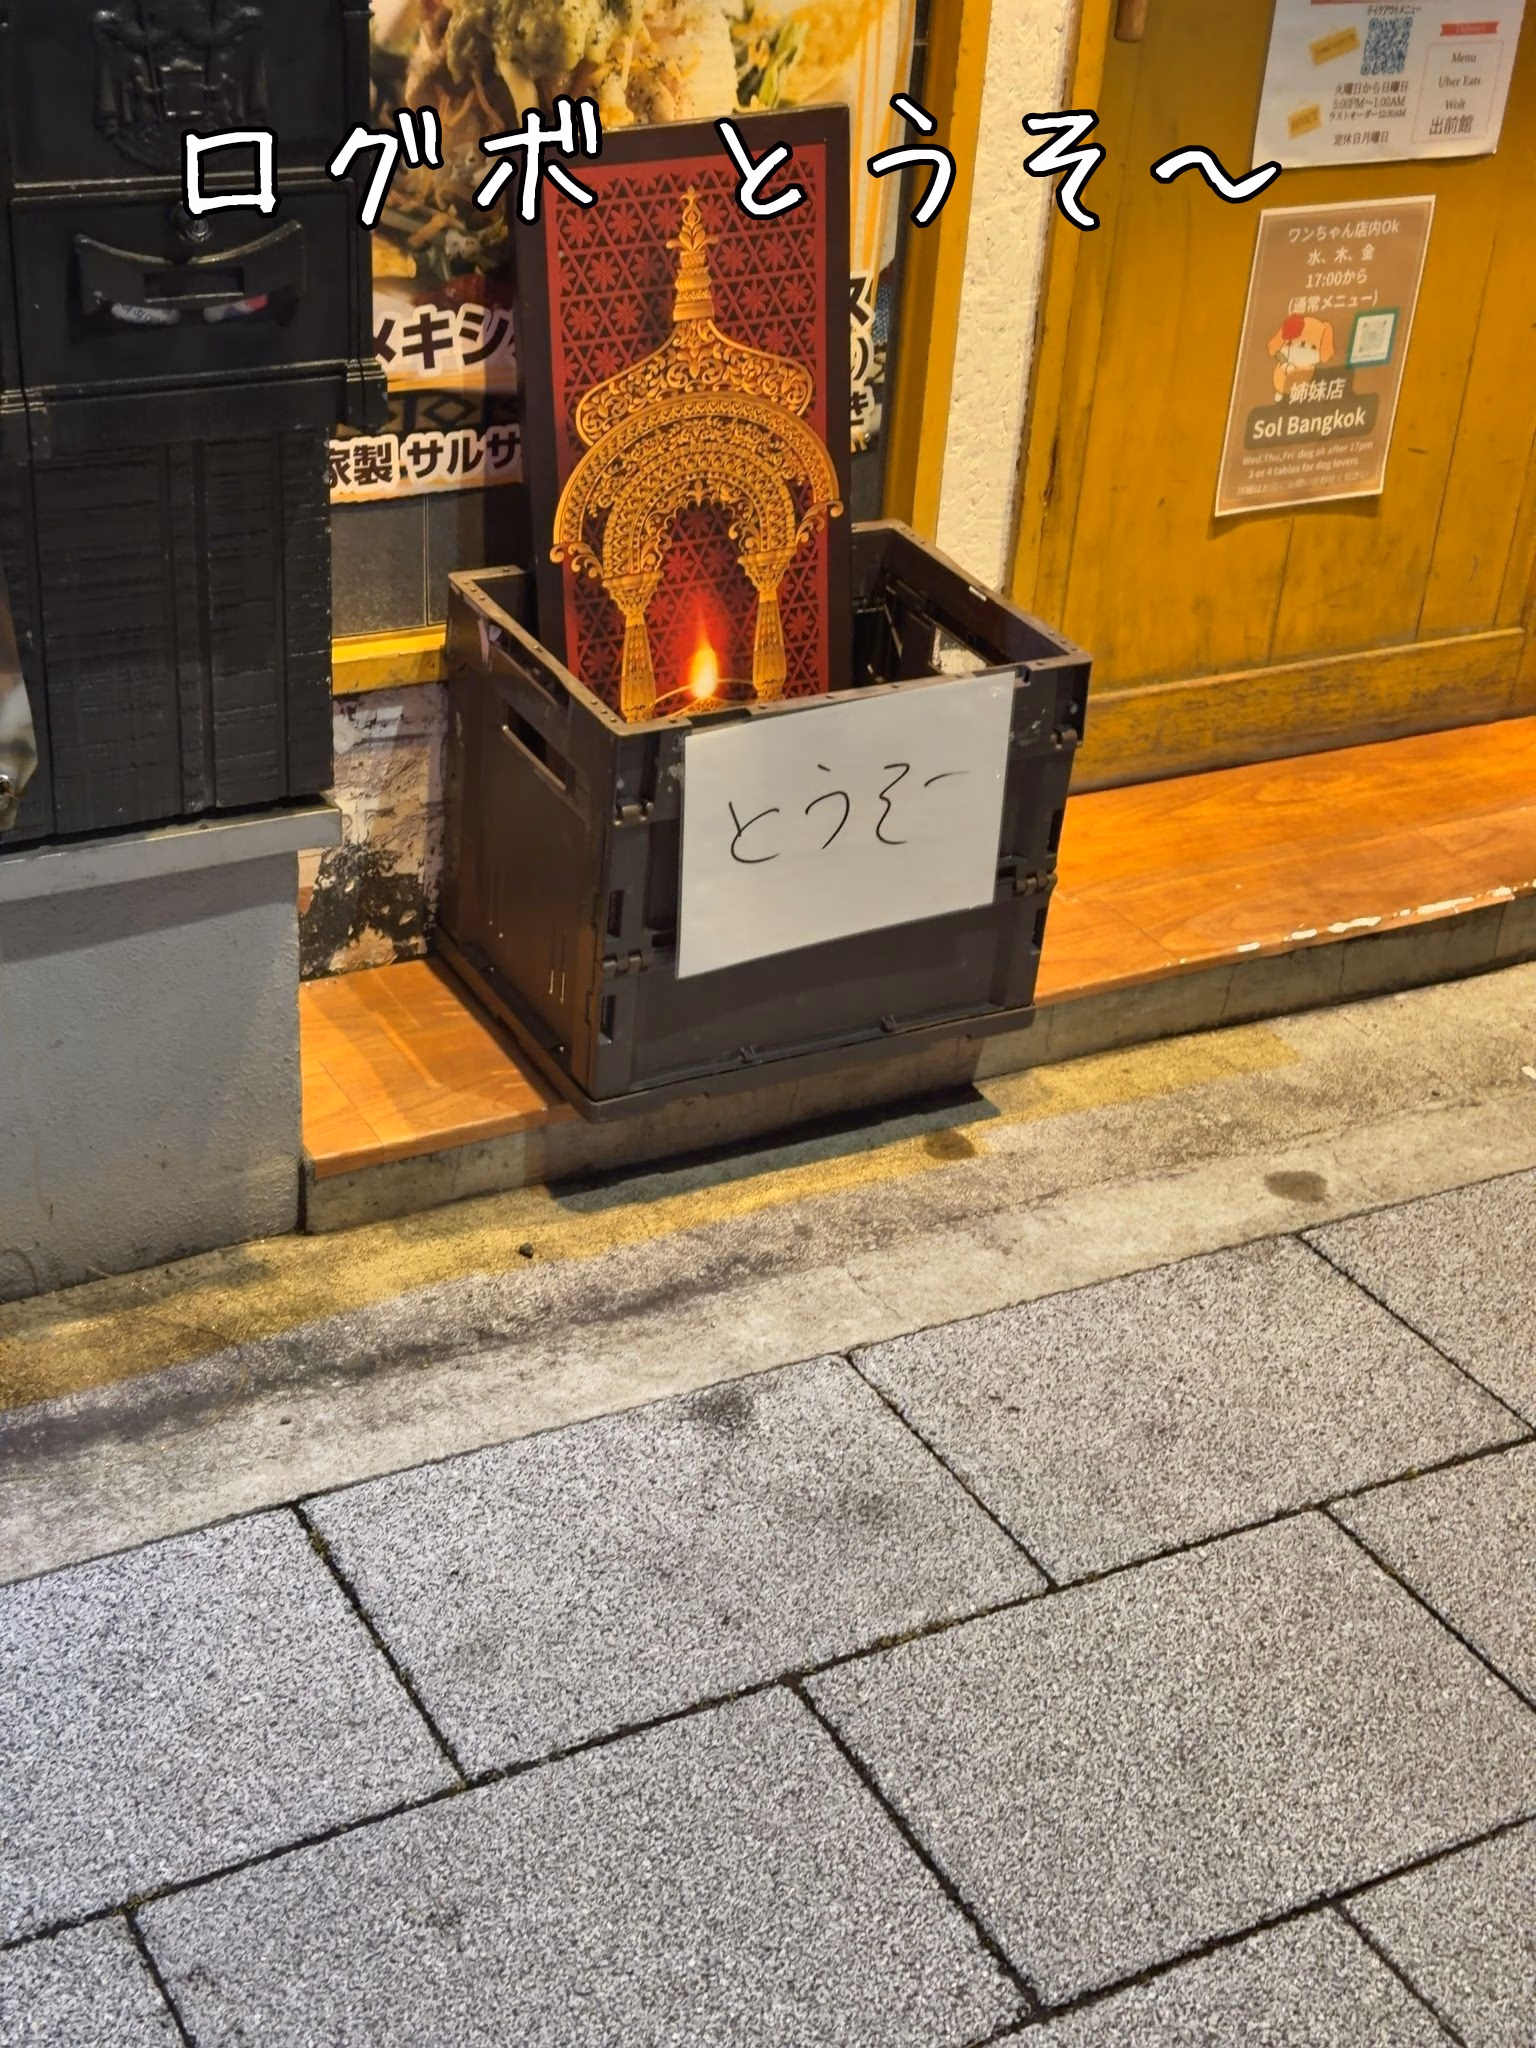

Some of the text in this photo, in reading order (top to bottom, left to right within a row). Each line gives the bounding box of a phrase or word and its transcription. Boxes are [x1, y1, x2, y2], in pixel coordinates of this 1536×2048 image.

[1450, 52, 1478, 64] Menu
[1334, 80, 1409, 96] 火曜日から日曜日
[1438, 75, 1482, 88] Uber Eats
[1445, 99, 1467, 111] Wolt
[1428, 114, 1475, 136] 出前館
[1333, 130, 1390, 146] 定休日月曜日
[1304, 267, 1368, 289] 17:00から
[372, 311, 517, 368] メキシ
[1287, 377, 1347, 405] 姉妹店
[1251, 404, 1368, 441] Sol Bangkok
